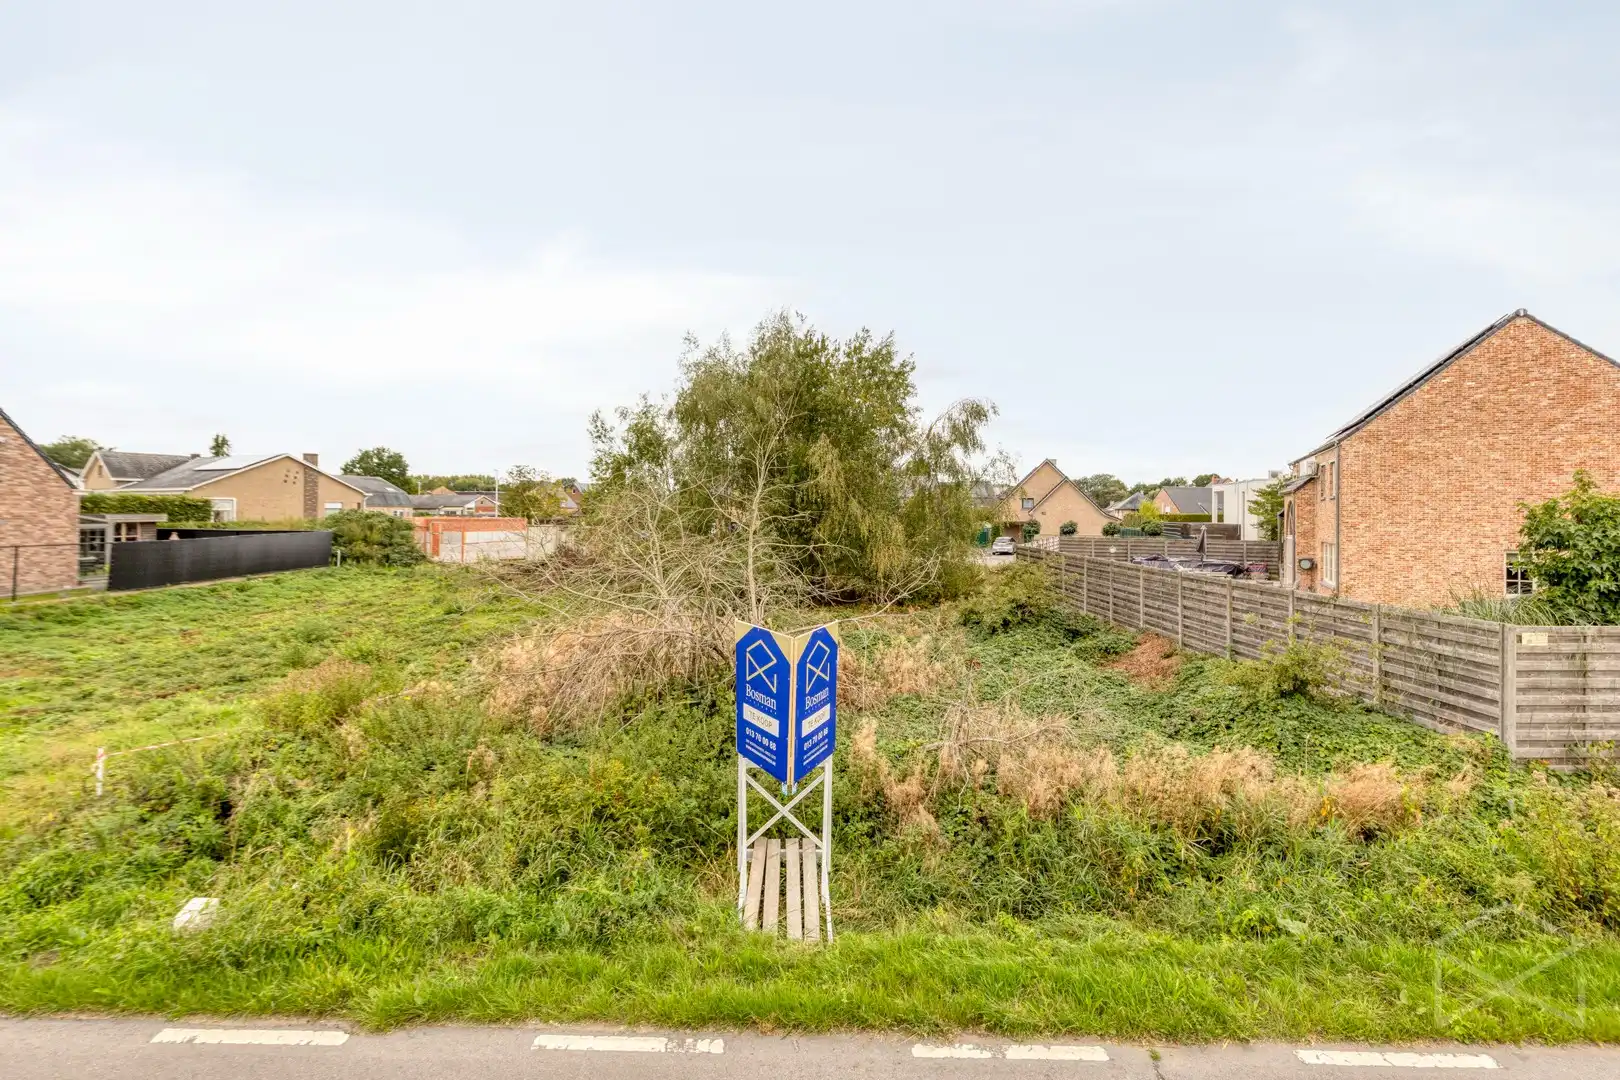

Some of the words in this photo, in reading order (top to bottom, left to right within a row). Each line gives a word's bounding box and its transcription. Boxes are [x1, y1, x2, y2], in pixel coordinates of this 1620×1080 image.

[746, 684, 776, 710] Bosman
[749, 710, 755, 720] TE
[757, 714, 772, 728] KOOP
[746, 727, 754, 738] 013
